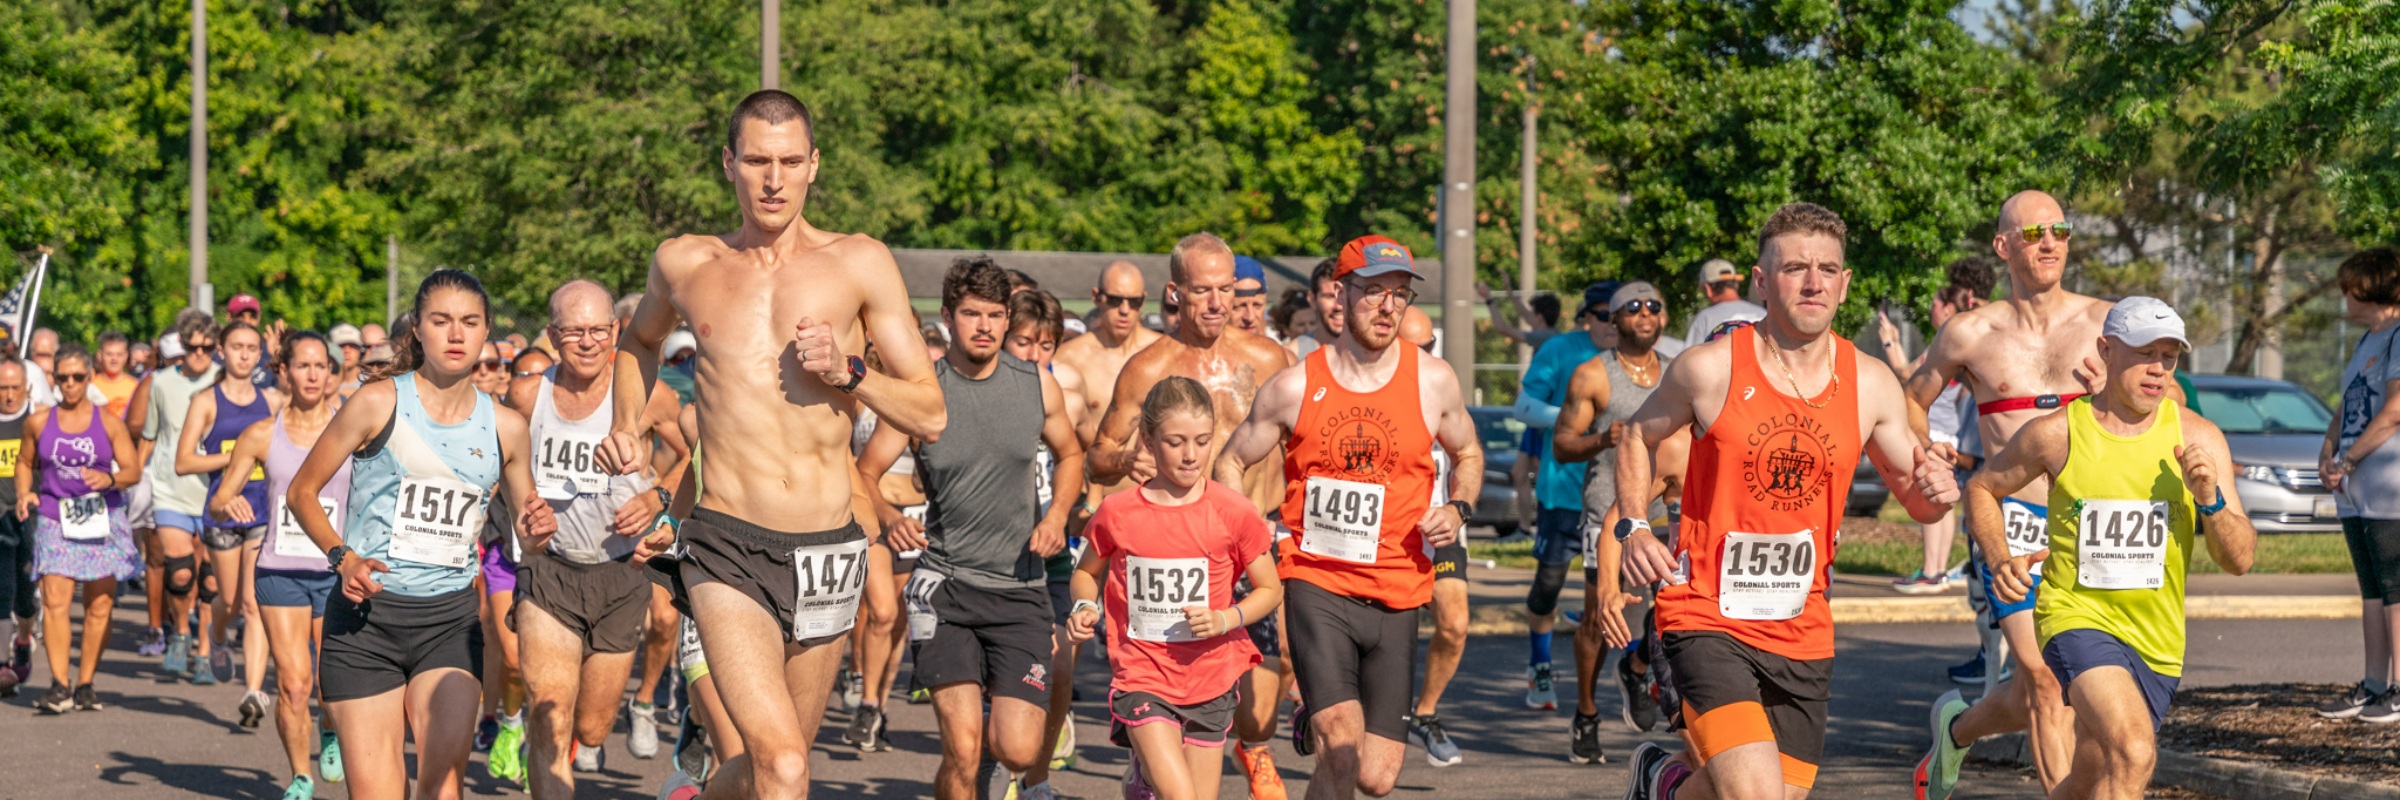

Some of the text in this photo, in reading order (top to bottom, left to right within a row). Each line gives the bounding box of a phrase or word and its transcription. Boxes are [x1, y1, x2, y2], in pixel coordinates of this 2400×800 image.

[1320, 406, 1399, 438] COLONIAL
[1747, 413, 1836, 456] COLONIAL
[546, 472, 572, 481] COLONIA
[1320, 450, 1344, 480] ROAD
[1743, 460, 1834, 511] ROAD RUNNERS
[400, 483, 478, 527] 1517
[1309, 485, 1379, 527] 1493
[405, 525, 463, 539] COLONIAL SPORTS
[1314, 521, 1368, 537] COLONIAL SPORTS
[2085, 509, 2164, 548] 1426
[802, 548, 866, 597] 1478
[1727, 541, 1812, 576] 1530
[1132, 566, 1205, 603] 1532
[804, 598, 834, 608] COLONIAL
[1138, 606, 1168, 614] COLONIAL
